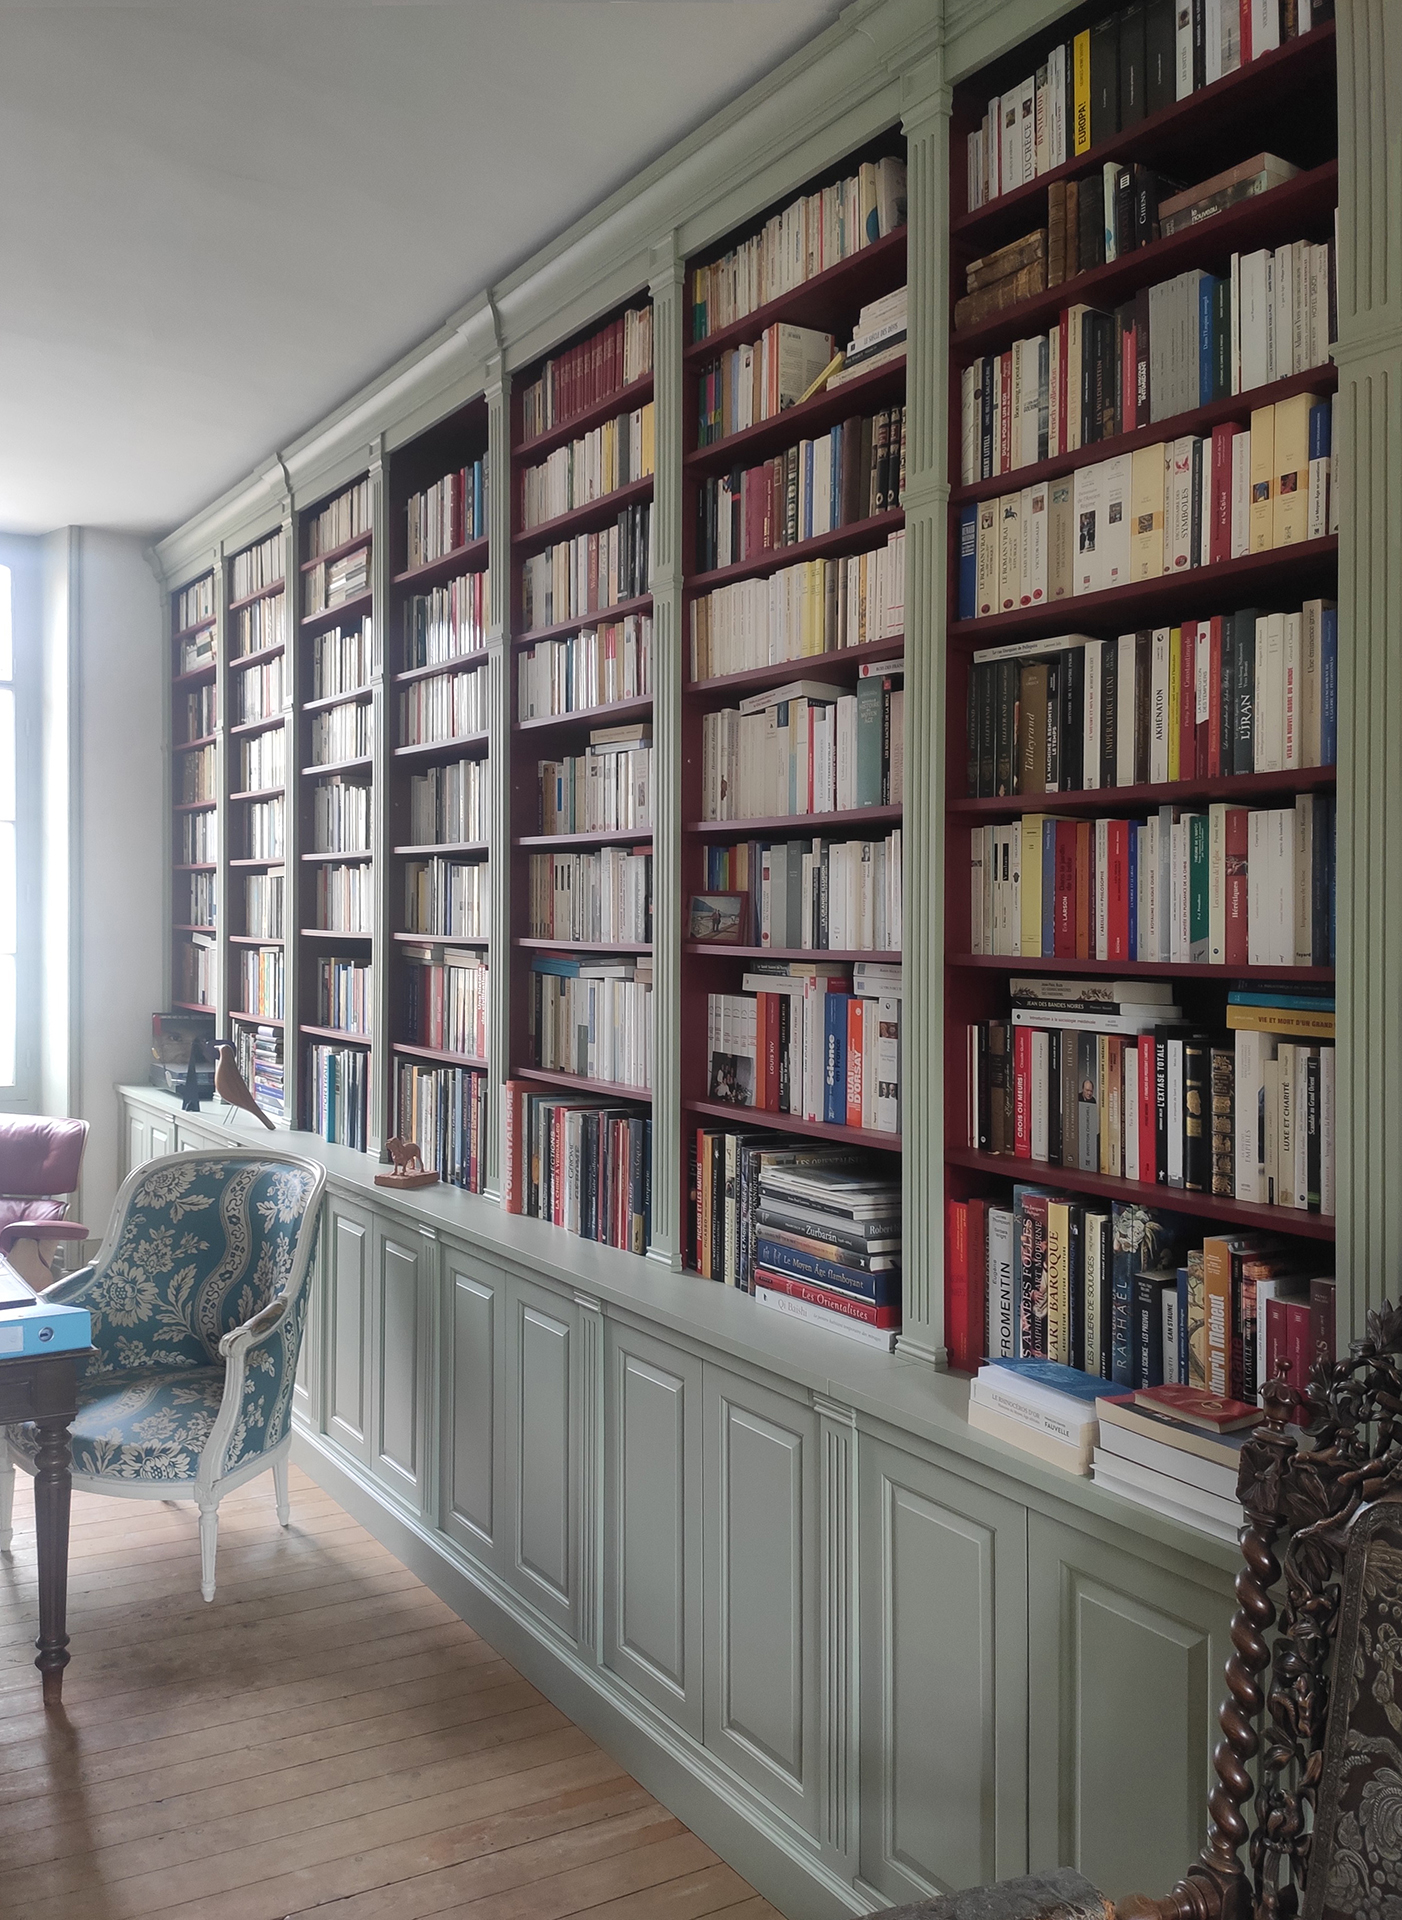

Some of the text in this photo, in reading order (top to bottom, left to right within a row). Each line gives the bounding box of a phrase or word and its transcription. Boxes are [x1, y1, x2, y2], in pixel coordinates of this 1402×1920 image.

[1078, 101, 1086, 146] EUROPA!
[1191, 205, 1218, 222] nouveau
[1002, 407, 1007, 417] UN
[980, 580, 985, 590] LE
[1002, 576, 1008, 584] LE
[1308, 609, 1316, 625] grise
[1106, 676, 1114, 694] CIXI
[1240, 695, 1252, 740] L'IRAN
[1024, 712, 1036, 771] Talleyrand
[1287, 735, 1293, 743] UN
[1052, 746, 1057, 755] LE
[835, 1071, 841, 1082] en
[1282, 1082, 1290, 1116] CHARITÉ
[1017, 1104, 1024, 1113] OU
[1284, 1118, 1290, 1128] ET
[806, 1225, 838, 1243] Zurbarán
[869, 1226, 893, 1237] Robert
[1034, 1221, 1043, 1268] MODERNE
[784, 1255, 864, 1289] Le Moyen Âge flamboyant
[802, 1288, 868, 1320] Les Orientalistes
[1049, 1230, 1061, 1362] L'ART BAROQUE
[778, 1298, 808, 1317] Qi Baishi
[1000, 1262, 1010, 1358] FROMENTIN
[1087, 1300, 1094, 1310] DE
[1246, 1378, 1252, 1388] LA
[1044, 1421, 1069, 1437] FAUVELLE
